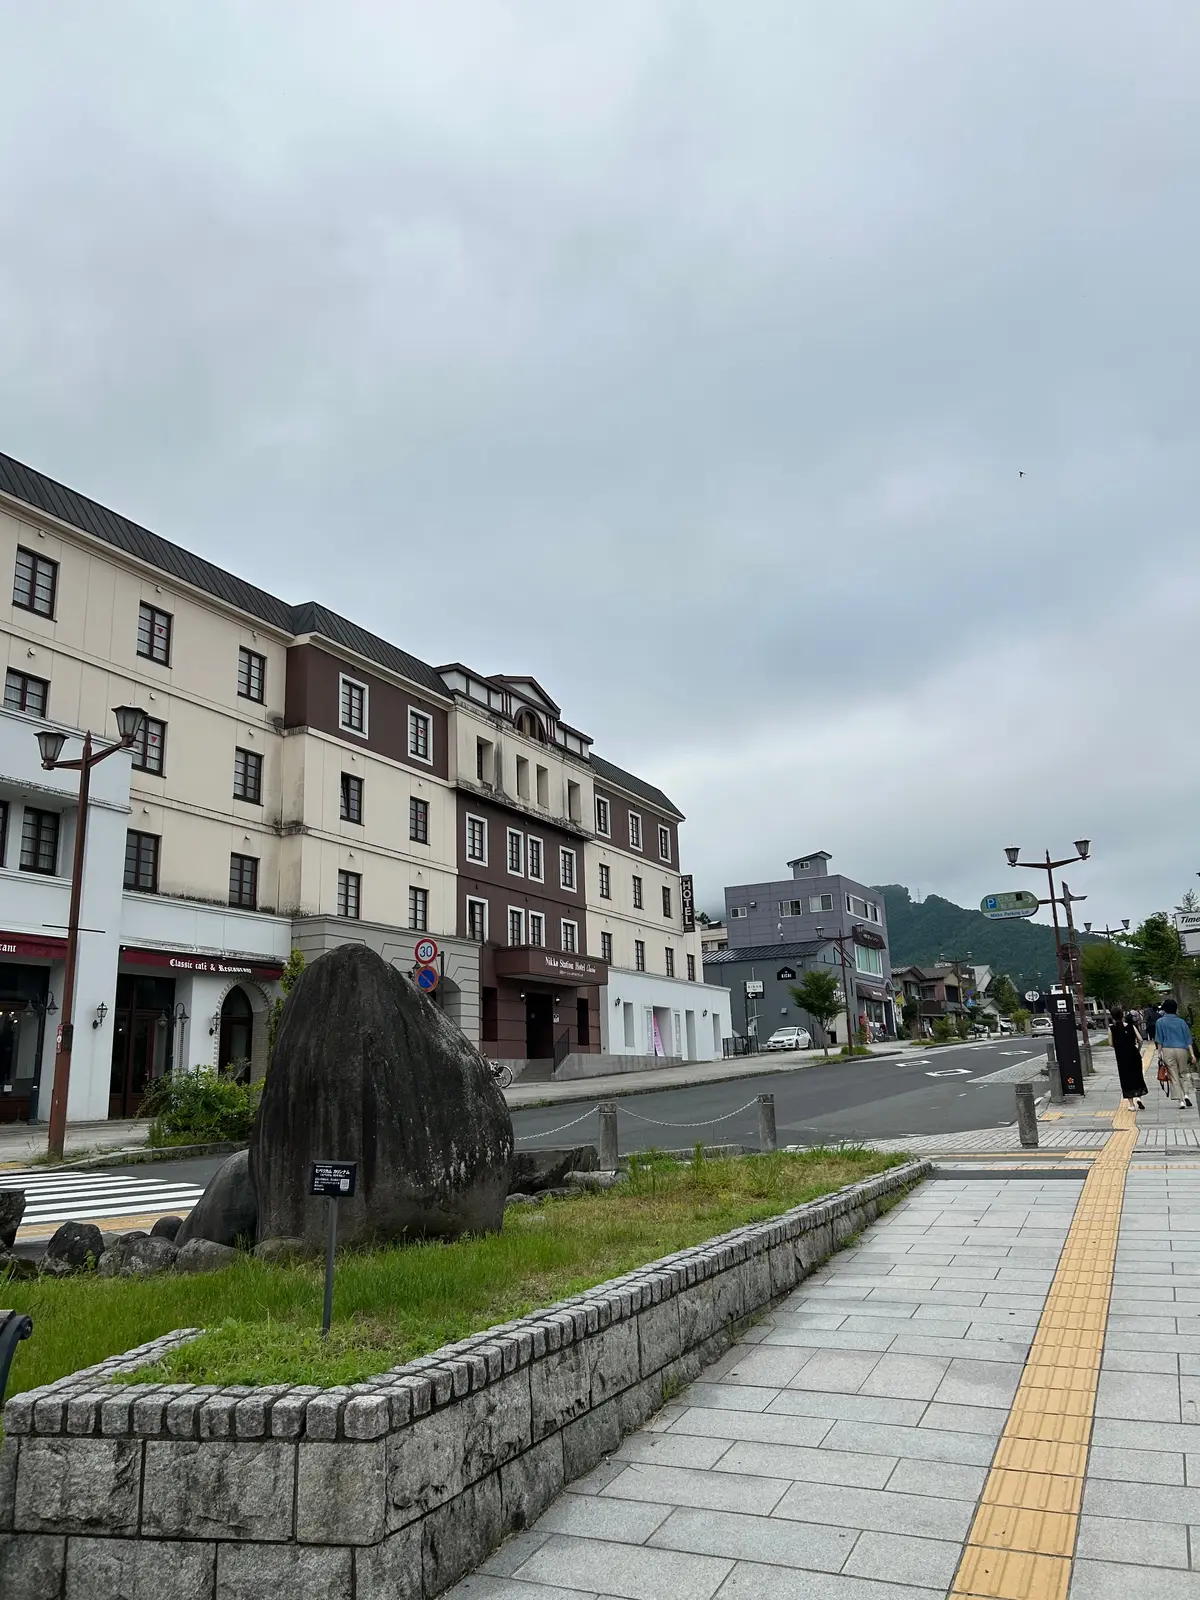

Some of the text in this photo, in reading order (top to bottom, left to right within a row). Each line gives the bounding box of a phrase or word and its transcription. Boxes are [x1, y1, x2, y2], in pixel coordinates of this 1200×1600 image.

[682, 881, 692, 925] HOTEL
[419, 945, 433, 958] 30
[169, 958, 193, 969] Classic
[210, 963, 216, 971] &
[545, 956, 558, 967] Nikko
[560, 959, 574, 970] Station
[574, 961, 586, 972] Hotel
